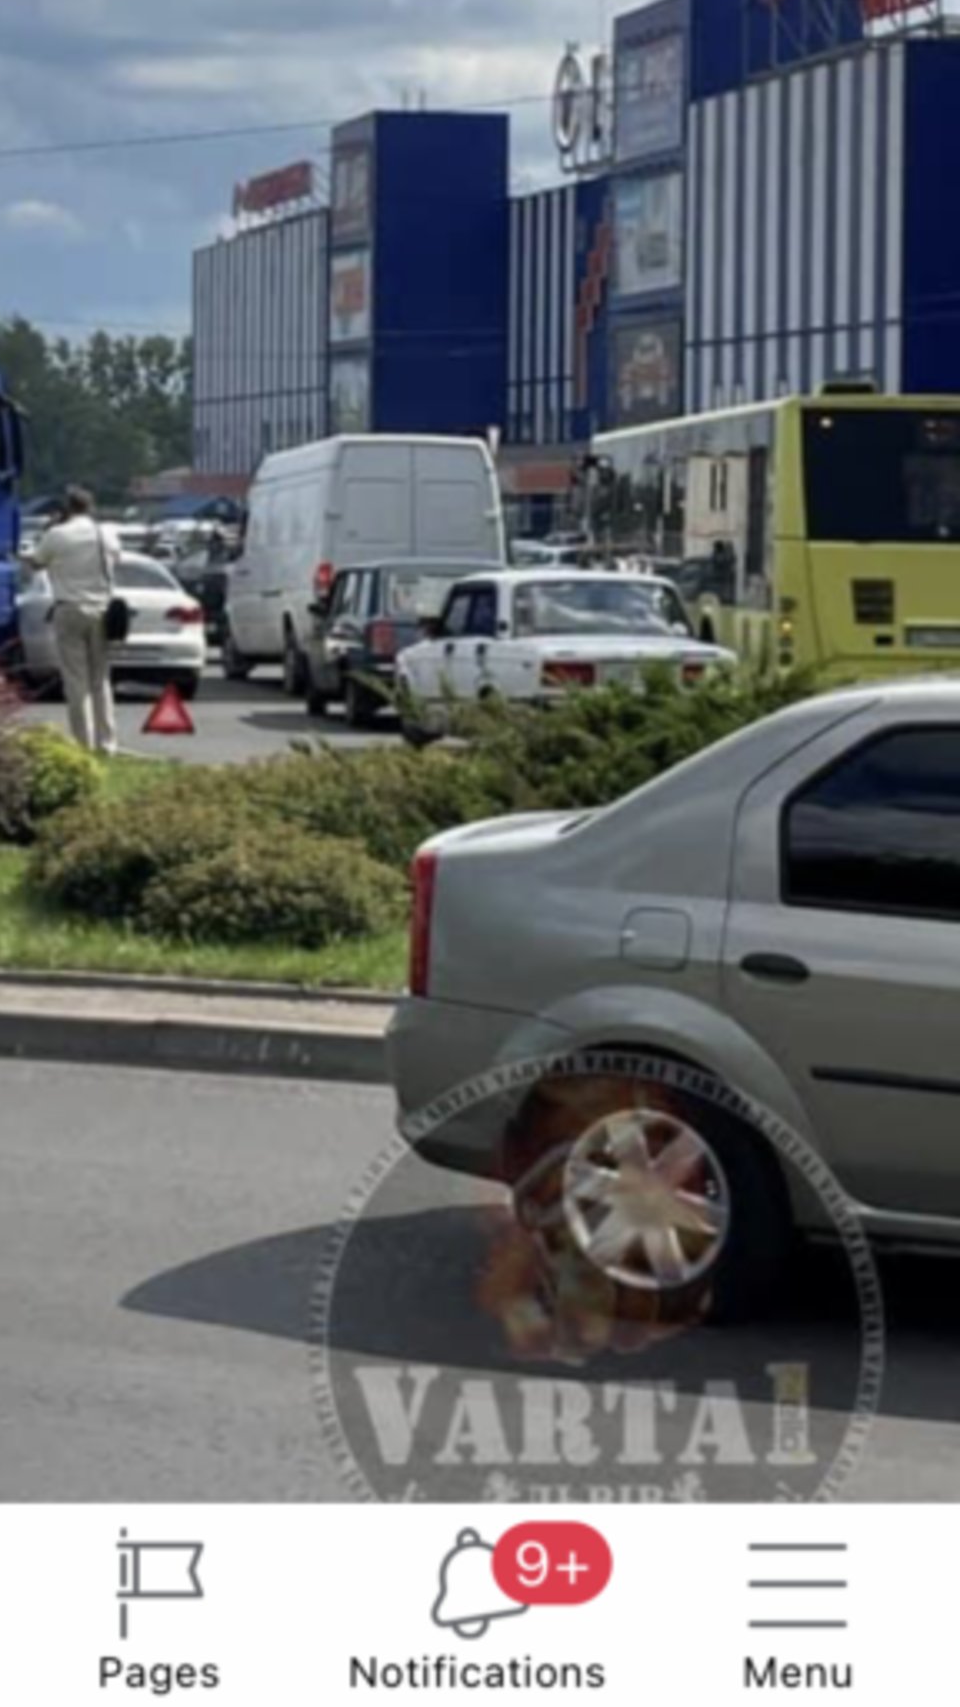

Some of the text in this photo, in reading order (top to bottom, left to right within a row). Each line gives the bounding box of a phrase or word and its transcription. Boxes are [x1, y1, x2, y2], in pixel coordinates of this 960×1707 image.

[515, 1539, 589, 1588] 9+
[97, 1655, 221, 1697] Pages
[348, 1654, 607, 1689] Notifications
[742, 1655, 853, 1689] Menu
